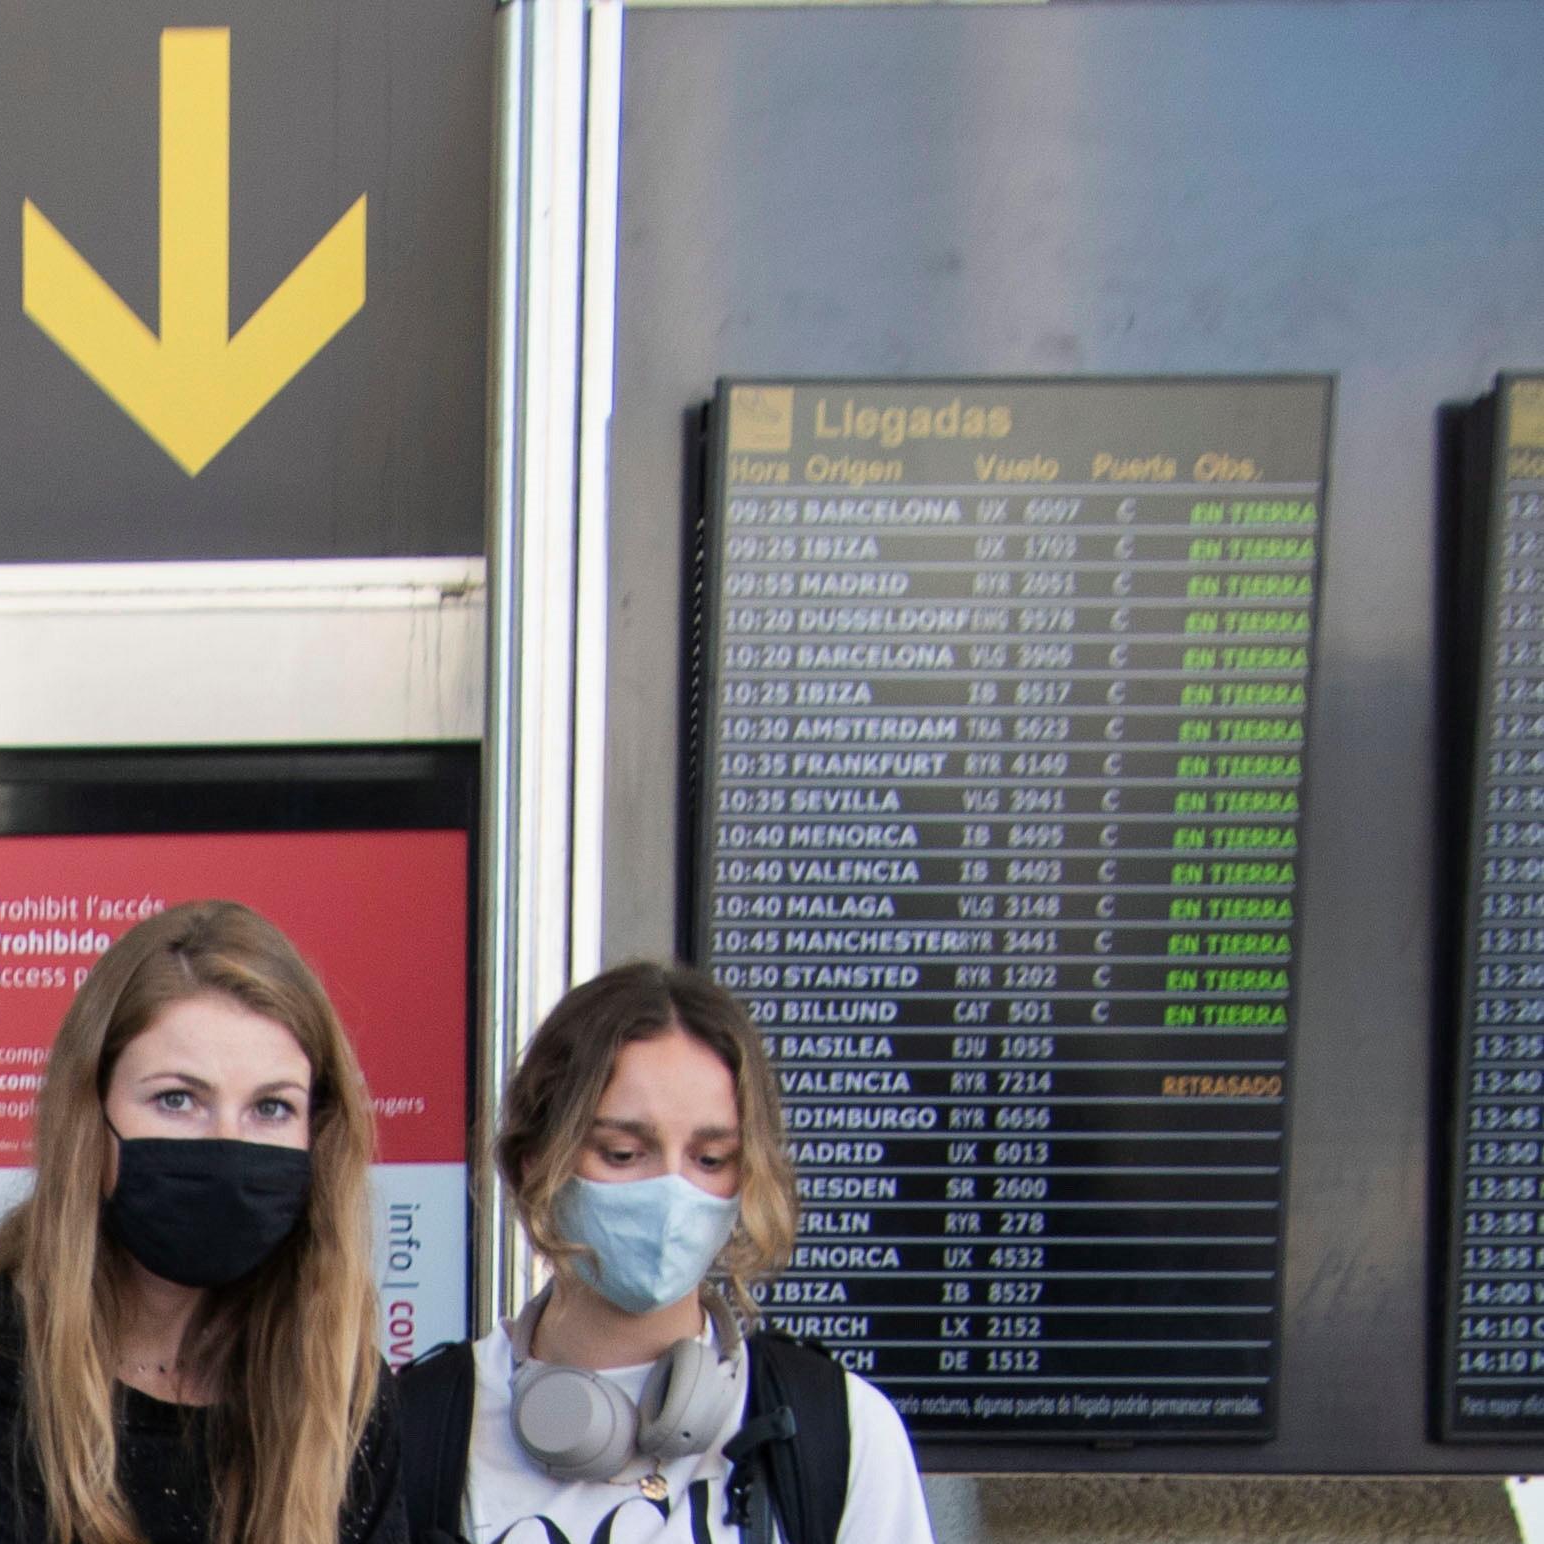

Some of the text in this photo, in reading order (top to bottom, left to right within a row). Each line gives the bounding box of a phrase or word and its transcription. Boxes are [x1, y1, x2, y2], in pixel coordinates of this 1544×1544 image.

[815, 399, 1013, 447] Llegadas
[730, 455, 790, 482] Hora
[804, 453, 903, 487] Origen
[975, 453, 1059, 482] Vuelo
[1091, 452, 1176, 481] Puerta
[802, 499, 962, 523] BARCELONA
[1190, 502, 1224, 525] EN
[1230, 502, 1317, 525] TIERRA
[801, 535, 880, 560] IBIZA
[1188, 538, 1223, 560] EN
[1228, 538, 1314, 560] TIERRA
[799, 572, 910, 597] MADRID
[1187, 574, 1220, 597] EN
[1225, 574, 1312, 597] TIERRA
[726, 607, 1310, 634] 10:20 DUSSELDORF EN TIERRA
[725, 644, 1308, 670] 10:20 BARCELONA EN TIERRA
[723, 680, 1306, 706] 10:25 IBIZA EN TIERRA
[721, 717, 1304, 742] 10:30 AMSTERDAM EN TIERRA
[720, 752, 1301, 777] 10:35 FRANKFURT EN TIERRA
[718, 788, 1298, 813] 10:35 SEVILLA EN TIERRA
[717, 825, 1297, 849] 10:40 MENORCA EN TIERRA
[715, 860, 1295, 885] 10:40 VALENCIA EN TIERRA
[714, 896, 1293, 920] 10:40 MALAGA EN TIERRA
[713, 930, 1291, 955] 10:45 MANCHESTER EN TIERRA
[712, 965, 1289, 991] 10:50 STANSTED EN TIERRA
[782, 1002, 898, 1023] BILLUND
[953, 1002, 991, 1023] CAT
[1008, 1002, 1053, 1023] 501
[1165, 1005, 1196, 1026] EN
[1202, 1005, 1288, 1026] TIERRA
[780, 1037, 1054, 1058] BASILEA EJU 1055
[780, 1072, 1282, 1097] VALENCIA RYR 7214 RETRASADO
[782, 1107, 1051, 1129] EDIMBURGO RYR 6656
[947, 1143, 977, 1164] UX
[993, 1142, 1049, 1164] 6013
[796, 1177, 1047, 1198] RESDEN SR 2600
[797, 1212, 1044, 1233] ERLIN RYR 278
[390, 1204, 421, 1271] info
[943, 1248, 972, 1268] UX
[989, 1248, 1044, 1268] 4532
[772, 1282, 847, 1303] IBIZA
[942, 1283, 970, 1302] IB
[988, 1282, 1043, 1303] 8527
[1463, 1282, 1531, 1304] 14:00
[940, 1317, 969, 1337] LX
[986, 1317, 1041, 1338] 2152
[1460, 1317, 1529, 1339] 14:10
[939, 1351, 1040, 1371] DE 1512
[1459, 1351, 1528, 1373] 14:10
